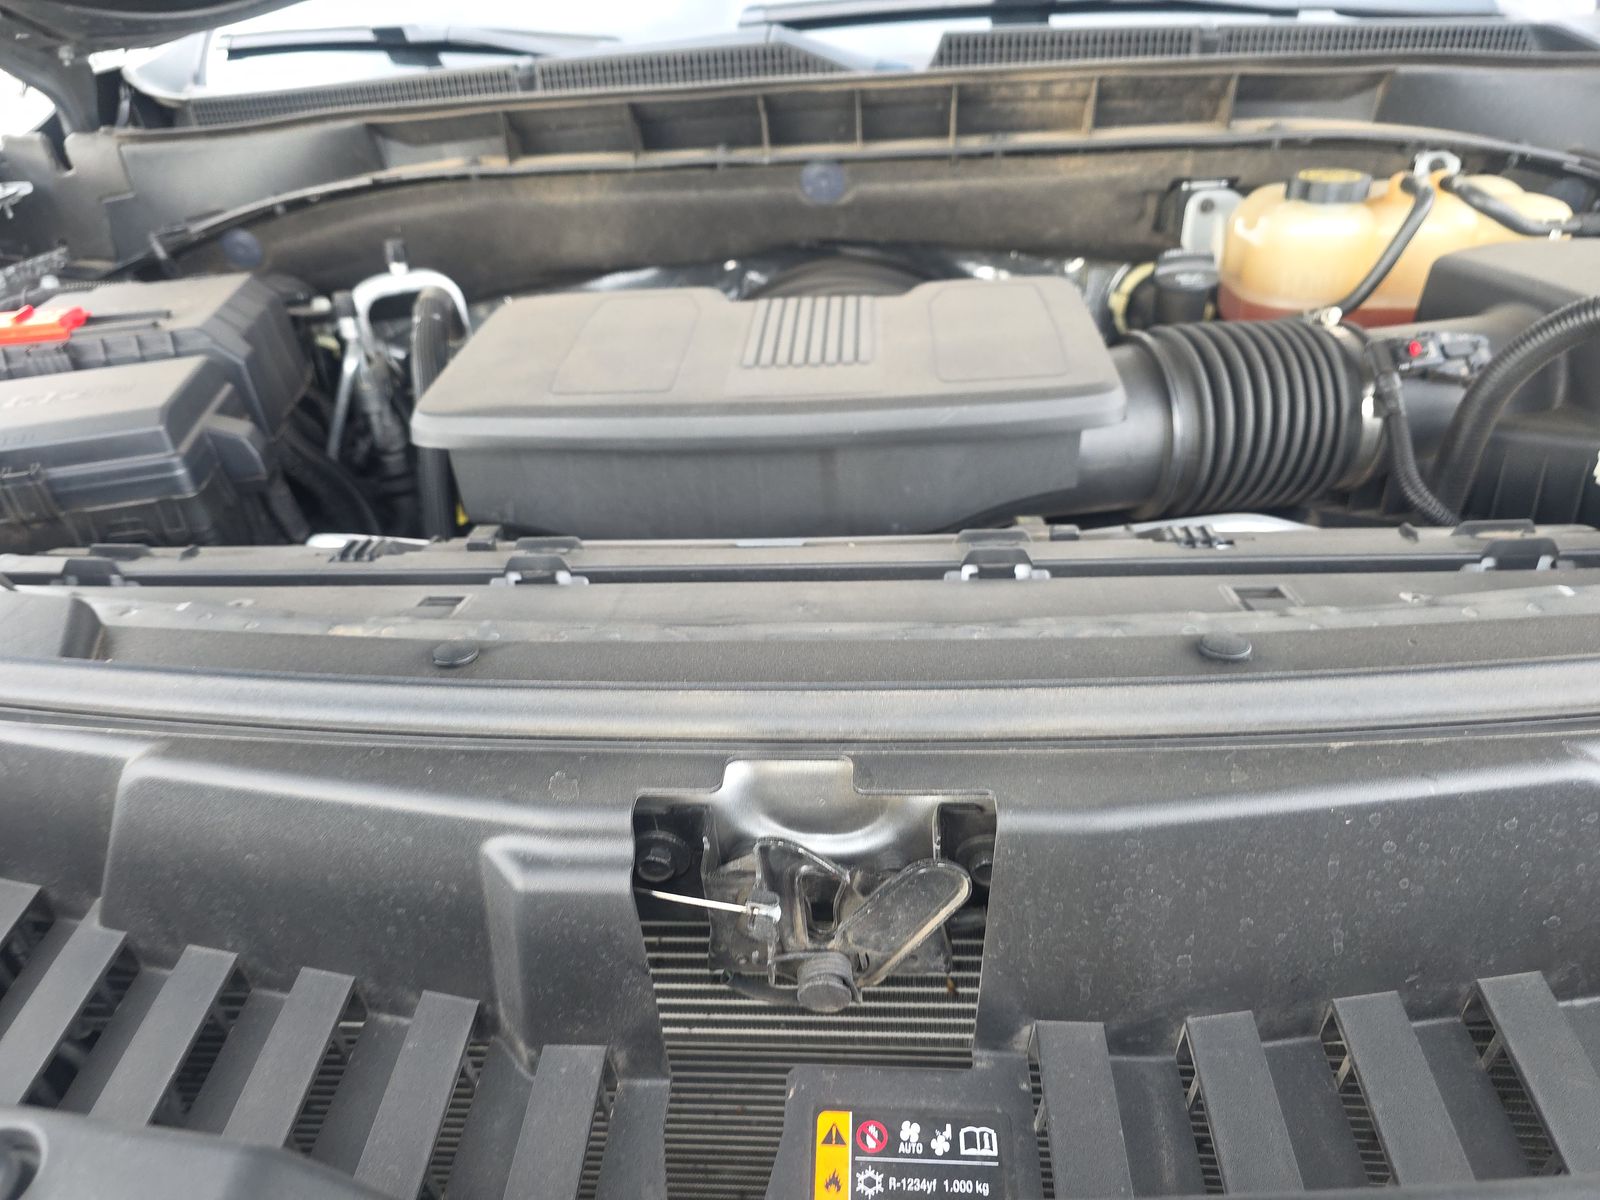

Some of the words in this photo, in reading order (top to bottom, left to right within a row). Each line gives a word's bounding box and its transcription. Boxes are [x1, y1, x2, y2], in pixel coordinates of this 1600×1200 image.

[898, 1142, 923, 1155] AUTO
[889, 1176, 937, 1193] R-1234yf
[943, 1179, 973, 1194] 1.000
[975, 1180, 990, 1197] kg
